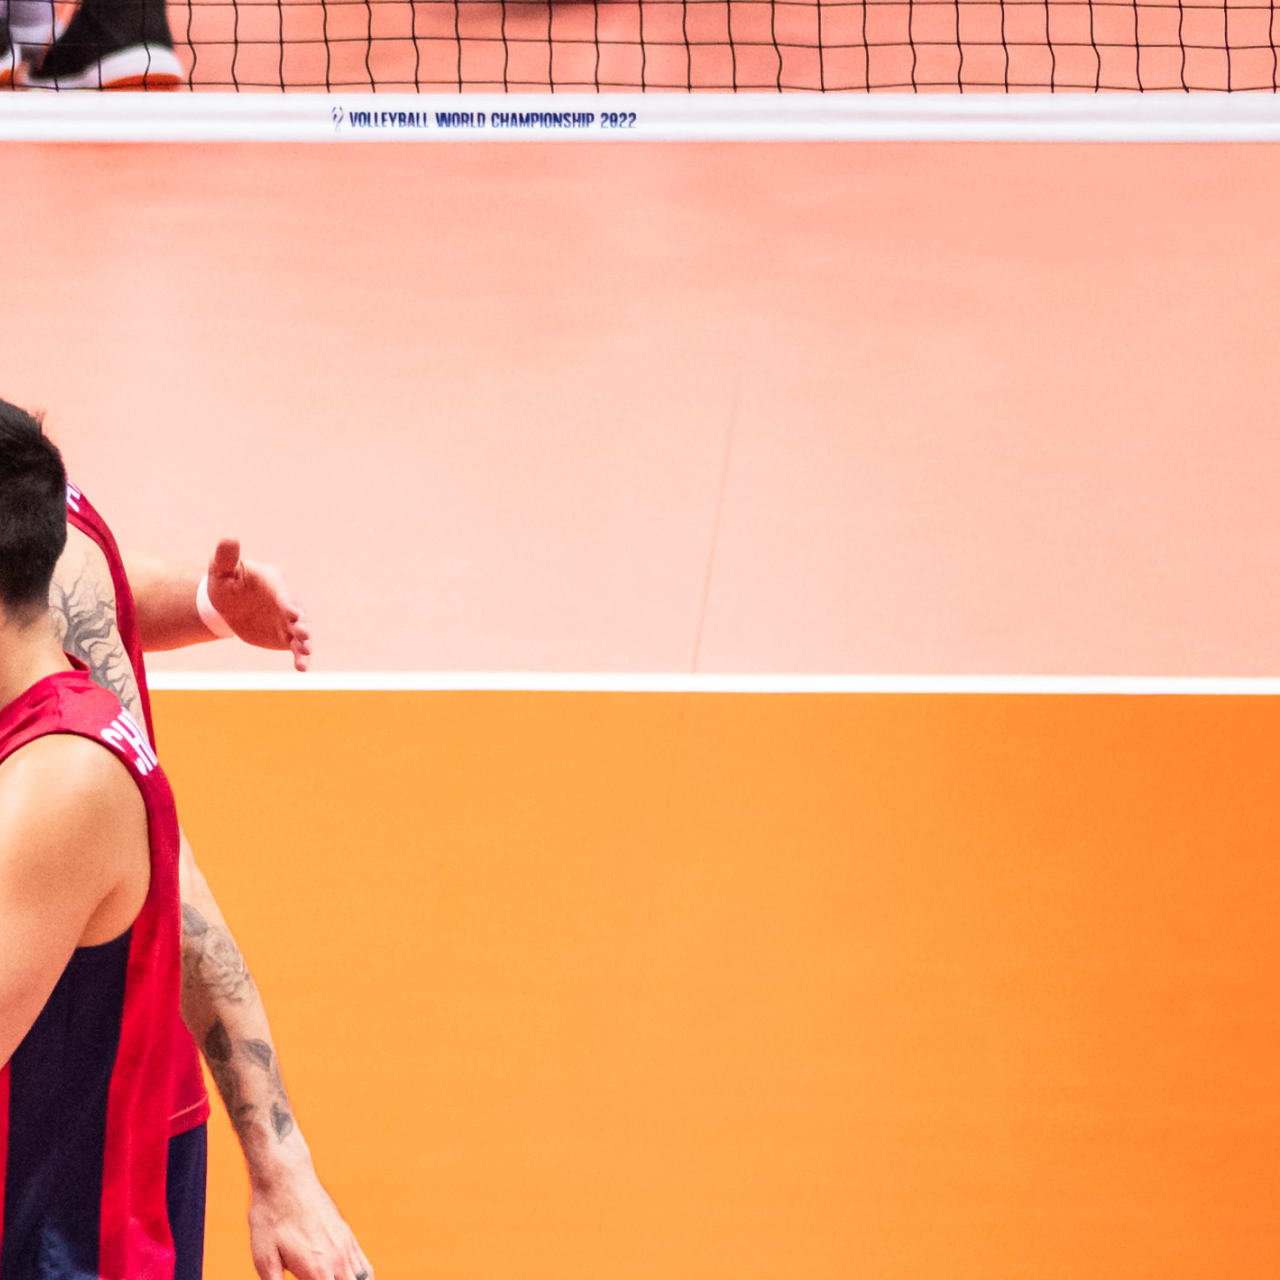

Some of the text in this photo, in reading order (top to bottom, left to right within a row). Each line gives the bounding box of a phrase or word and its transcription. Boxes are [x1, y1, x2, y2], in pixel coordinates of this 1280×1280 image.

[349, 111, 638, 128] VOLLEYBALL WORLD CHAMPIONSHIP 2022
